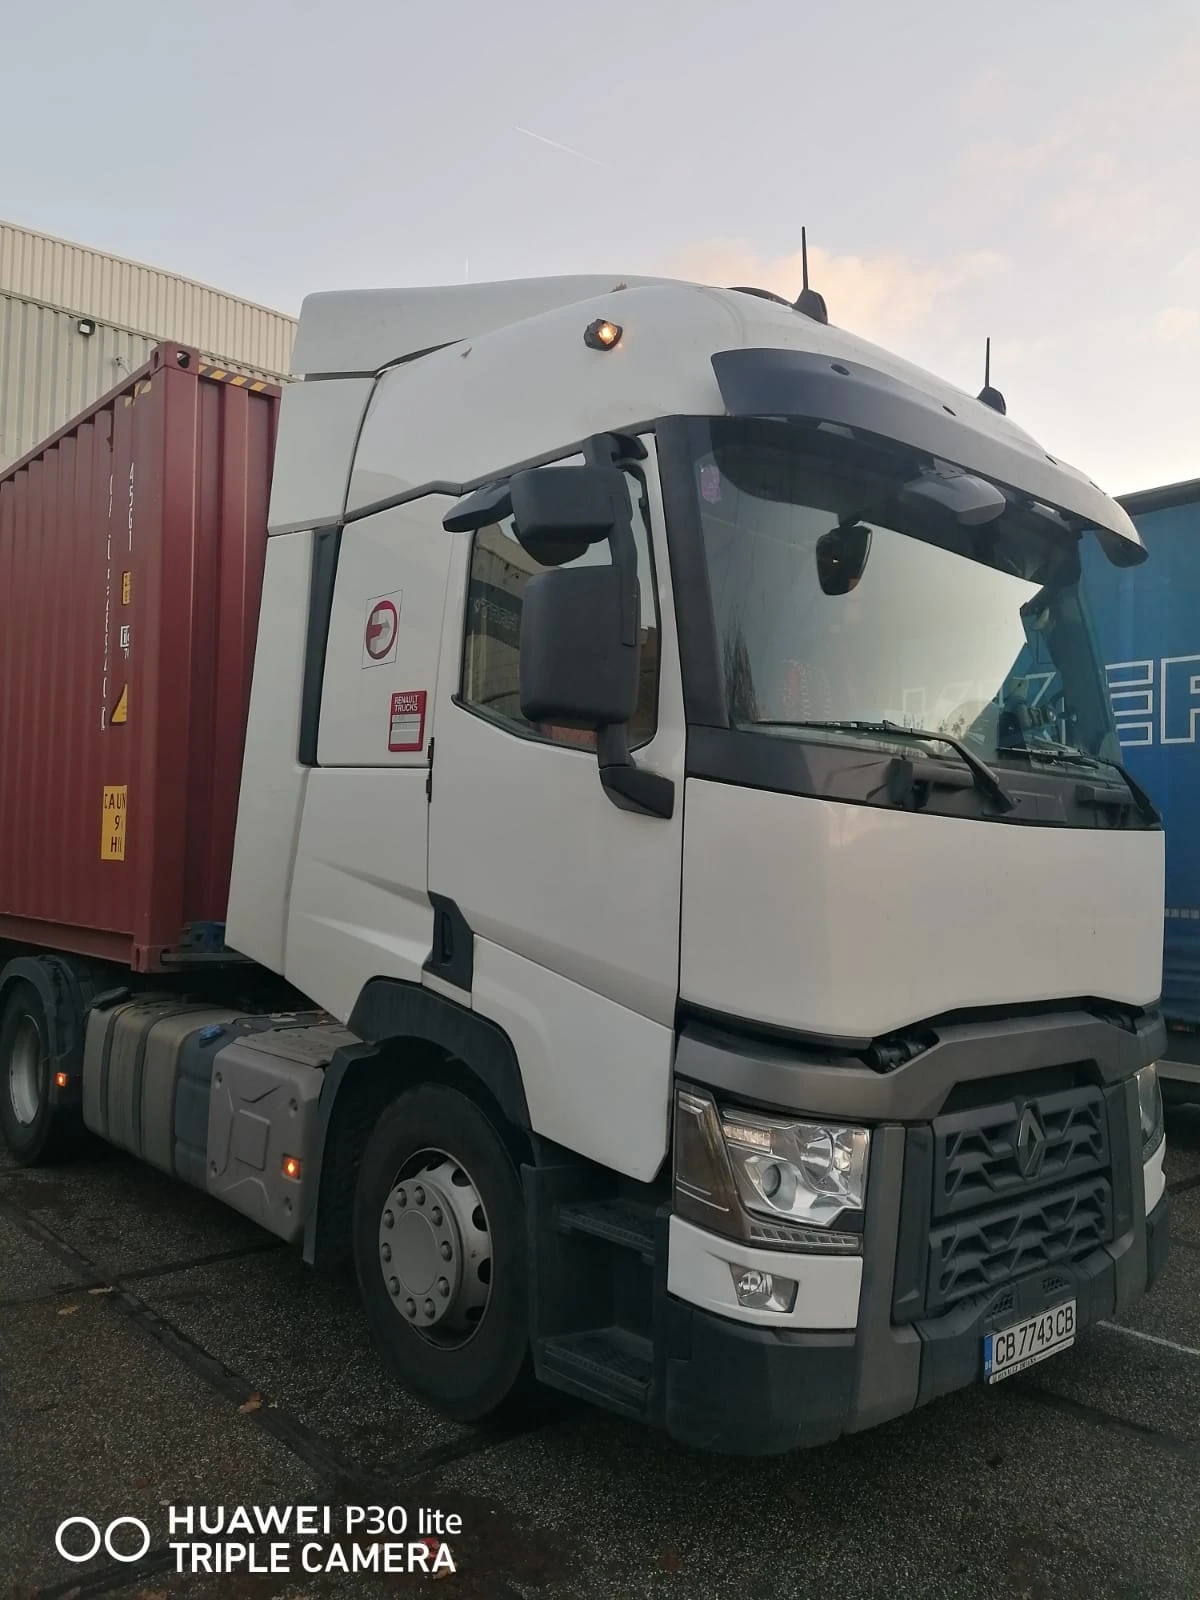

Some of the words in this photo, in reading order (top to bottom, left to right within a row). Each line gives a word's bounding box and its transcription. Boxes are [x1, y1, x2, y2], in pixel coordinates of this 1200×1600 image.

[394, 695, 419, 705] RENAULT
[394, 703, 418, 712] TRUCKS
[995, 1332, 1016, 1366] CB
[1019, 1315, 1054, 1356] 7743
[1056, 1306, 1074, 1337] CB
